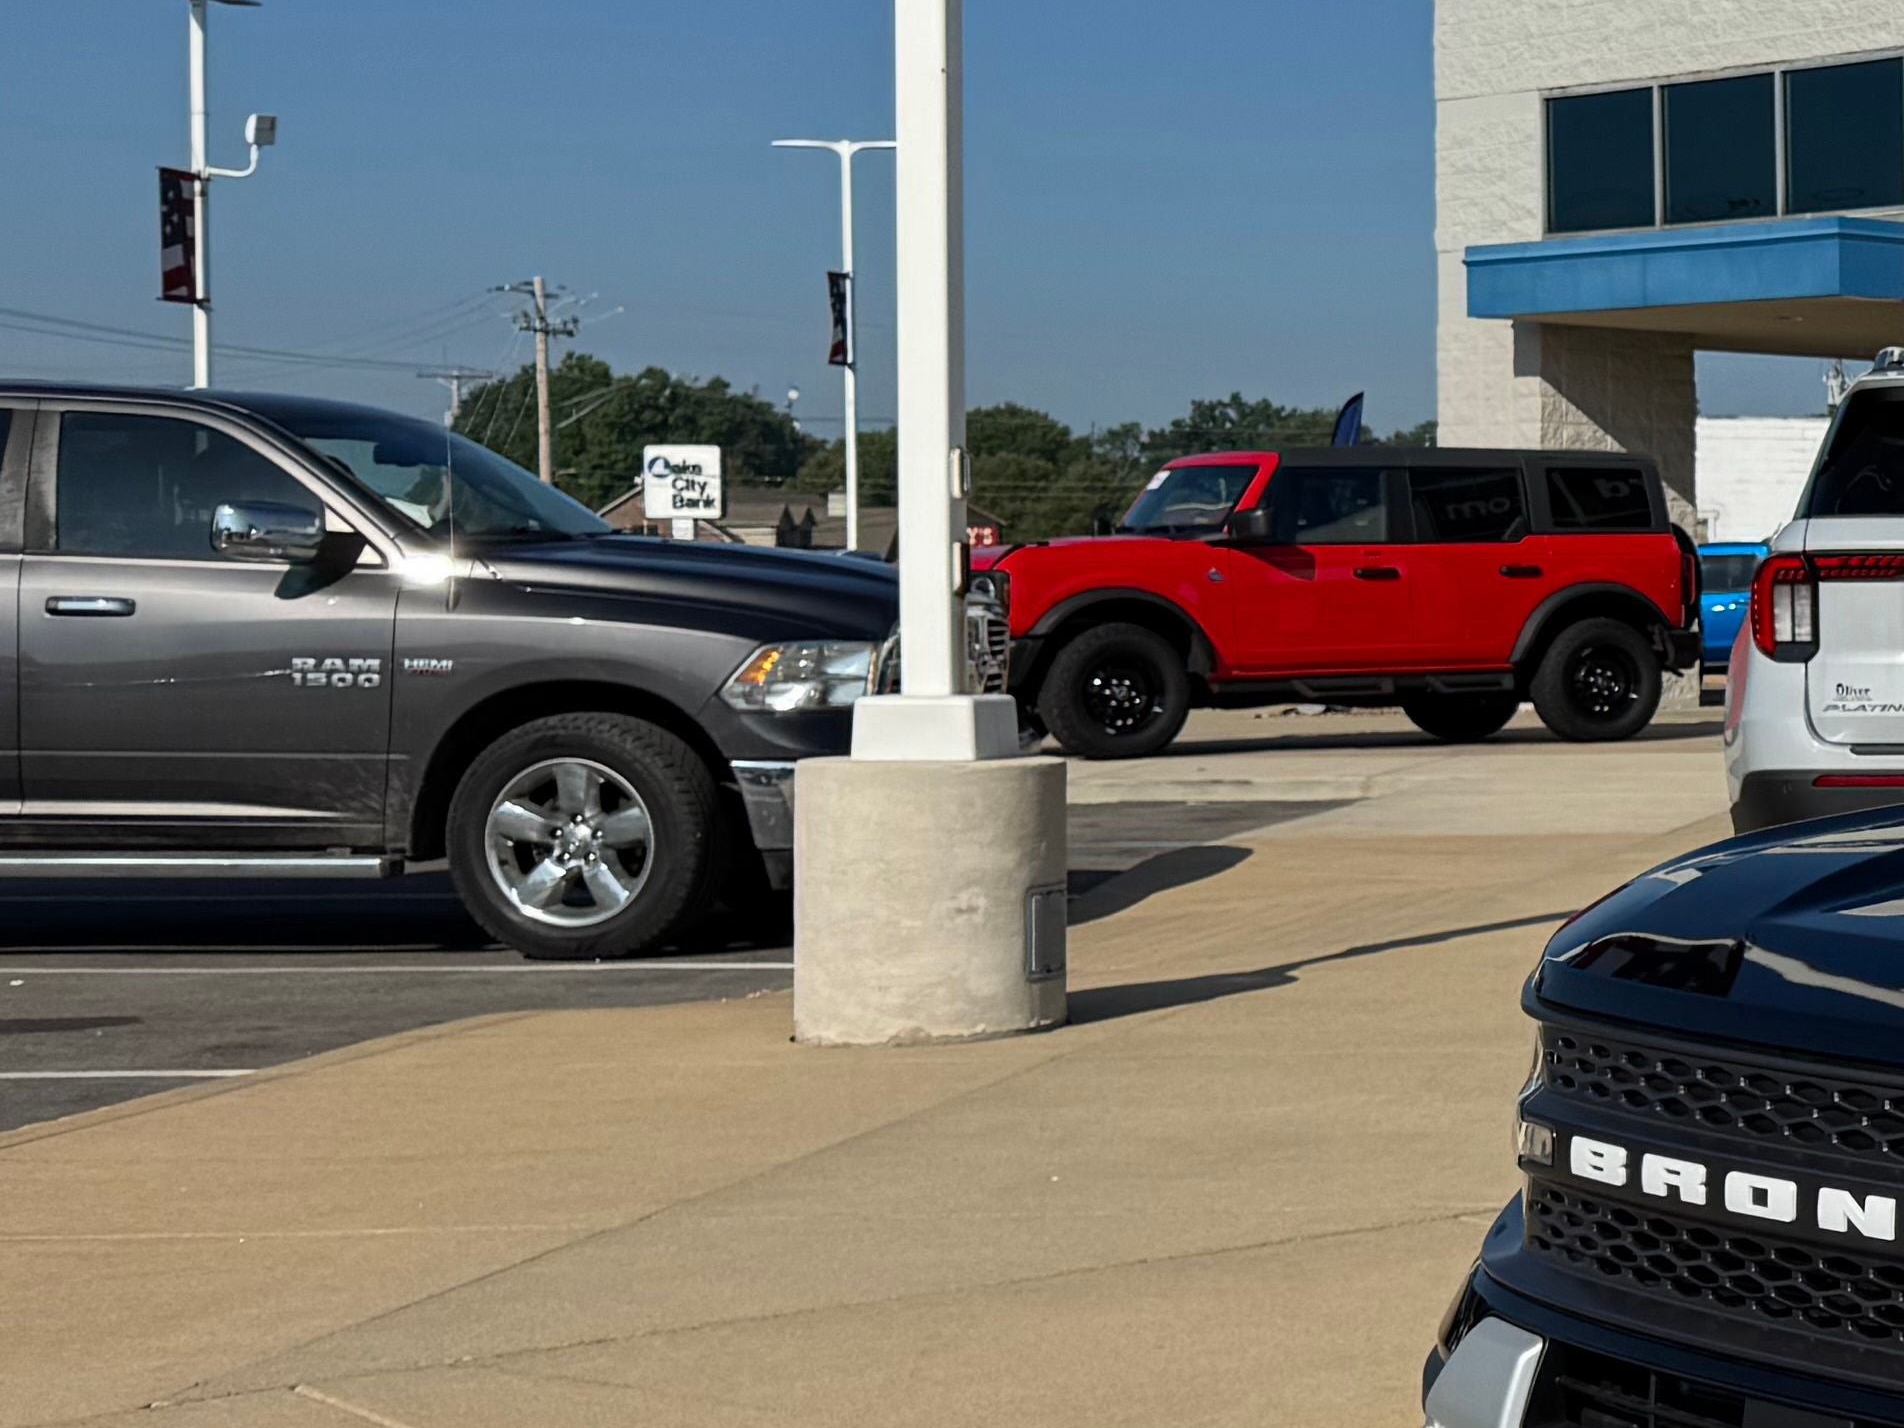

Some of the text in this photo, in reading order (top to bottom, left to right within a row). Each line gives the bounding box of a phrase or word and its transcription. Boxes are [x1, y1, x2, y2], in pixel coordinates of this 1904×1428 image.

[672, 476, 708, 497] City
[672, 492, 717, 509] Bank
[292, 658, 381, 672] RAM
[292, 673, 380, 687] 1500
